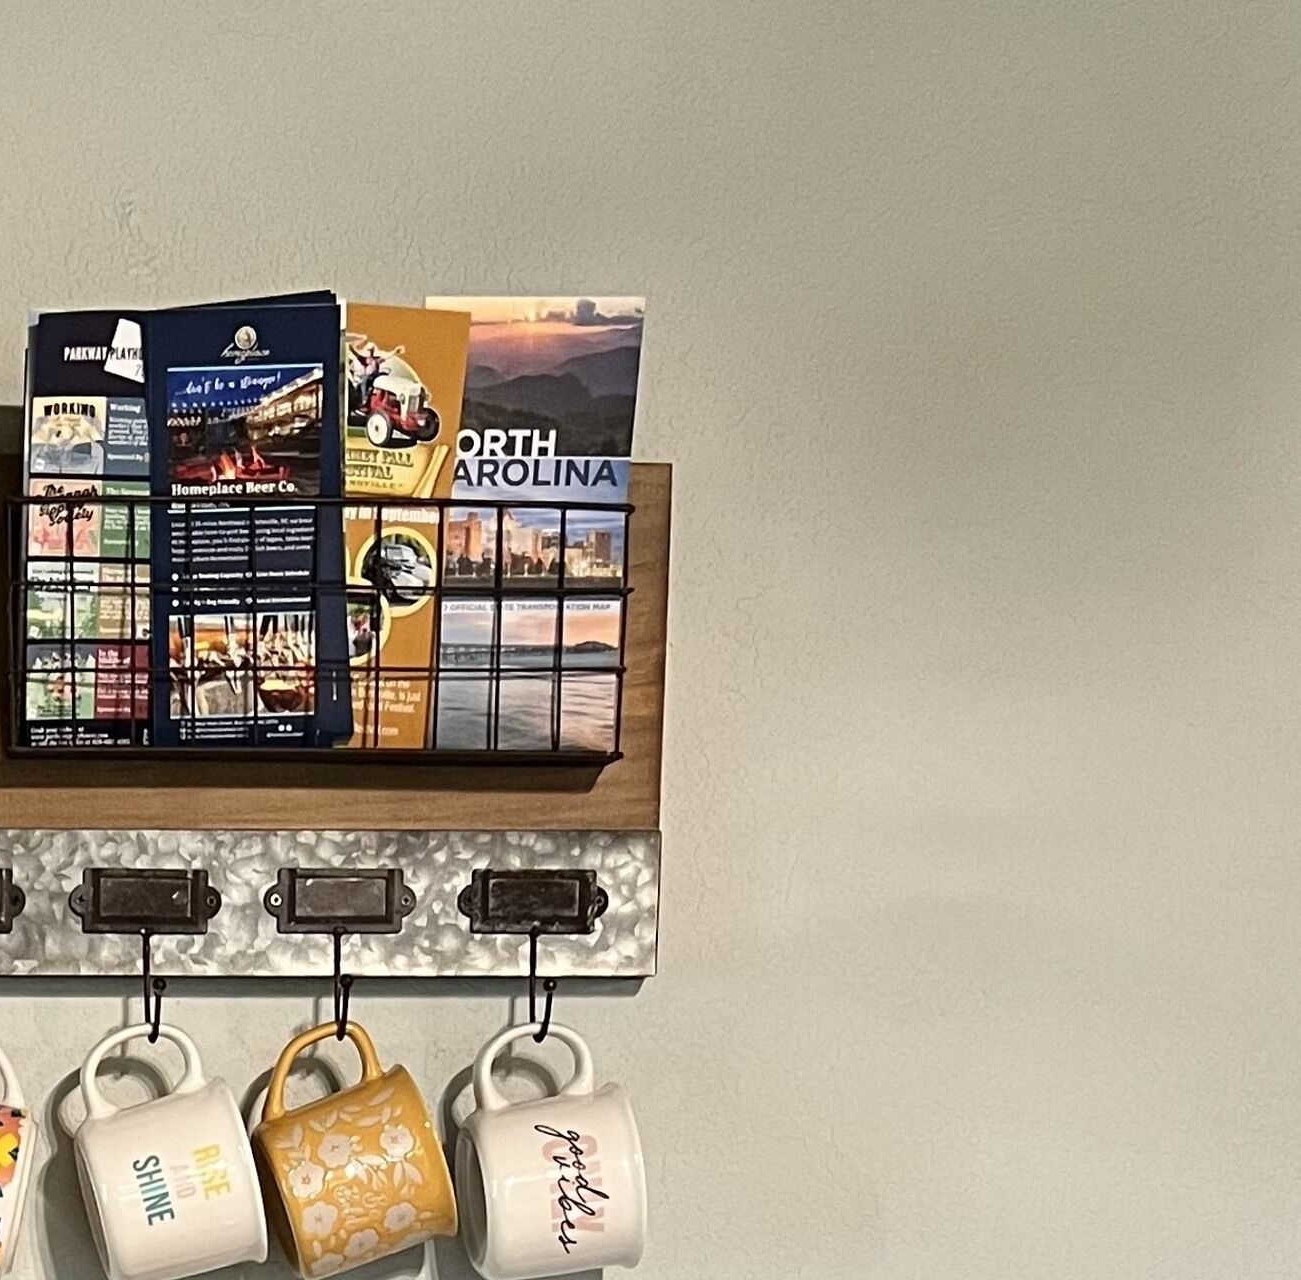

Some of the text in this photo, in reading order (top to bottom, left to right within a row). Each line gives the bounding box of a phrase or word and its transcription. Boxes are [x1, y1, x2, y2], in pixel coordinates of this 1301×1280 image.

[64, 347, 108, 361] PARKWAY
[44, 402, 97, 417] WORKING
[456, 429, 557, 458] ORTH
[453, 459, 618, 487] AROLINA
[171, 480, 298, 497] Homeplace Beer Co.
[193, 1144, 231, 1200] RISE
[534, 1124, 610, 1204] good
[132, 1155, 175, 1226] SHINE
[552, 1155, 596, 1254] vibes
